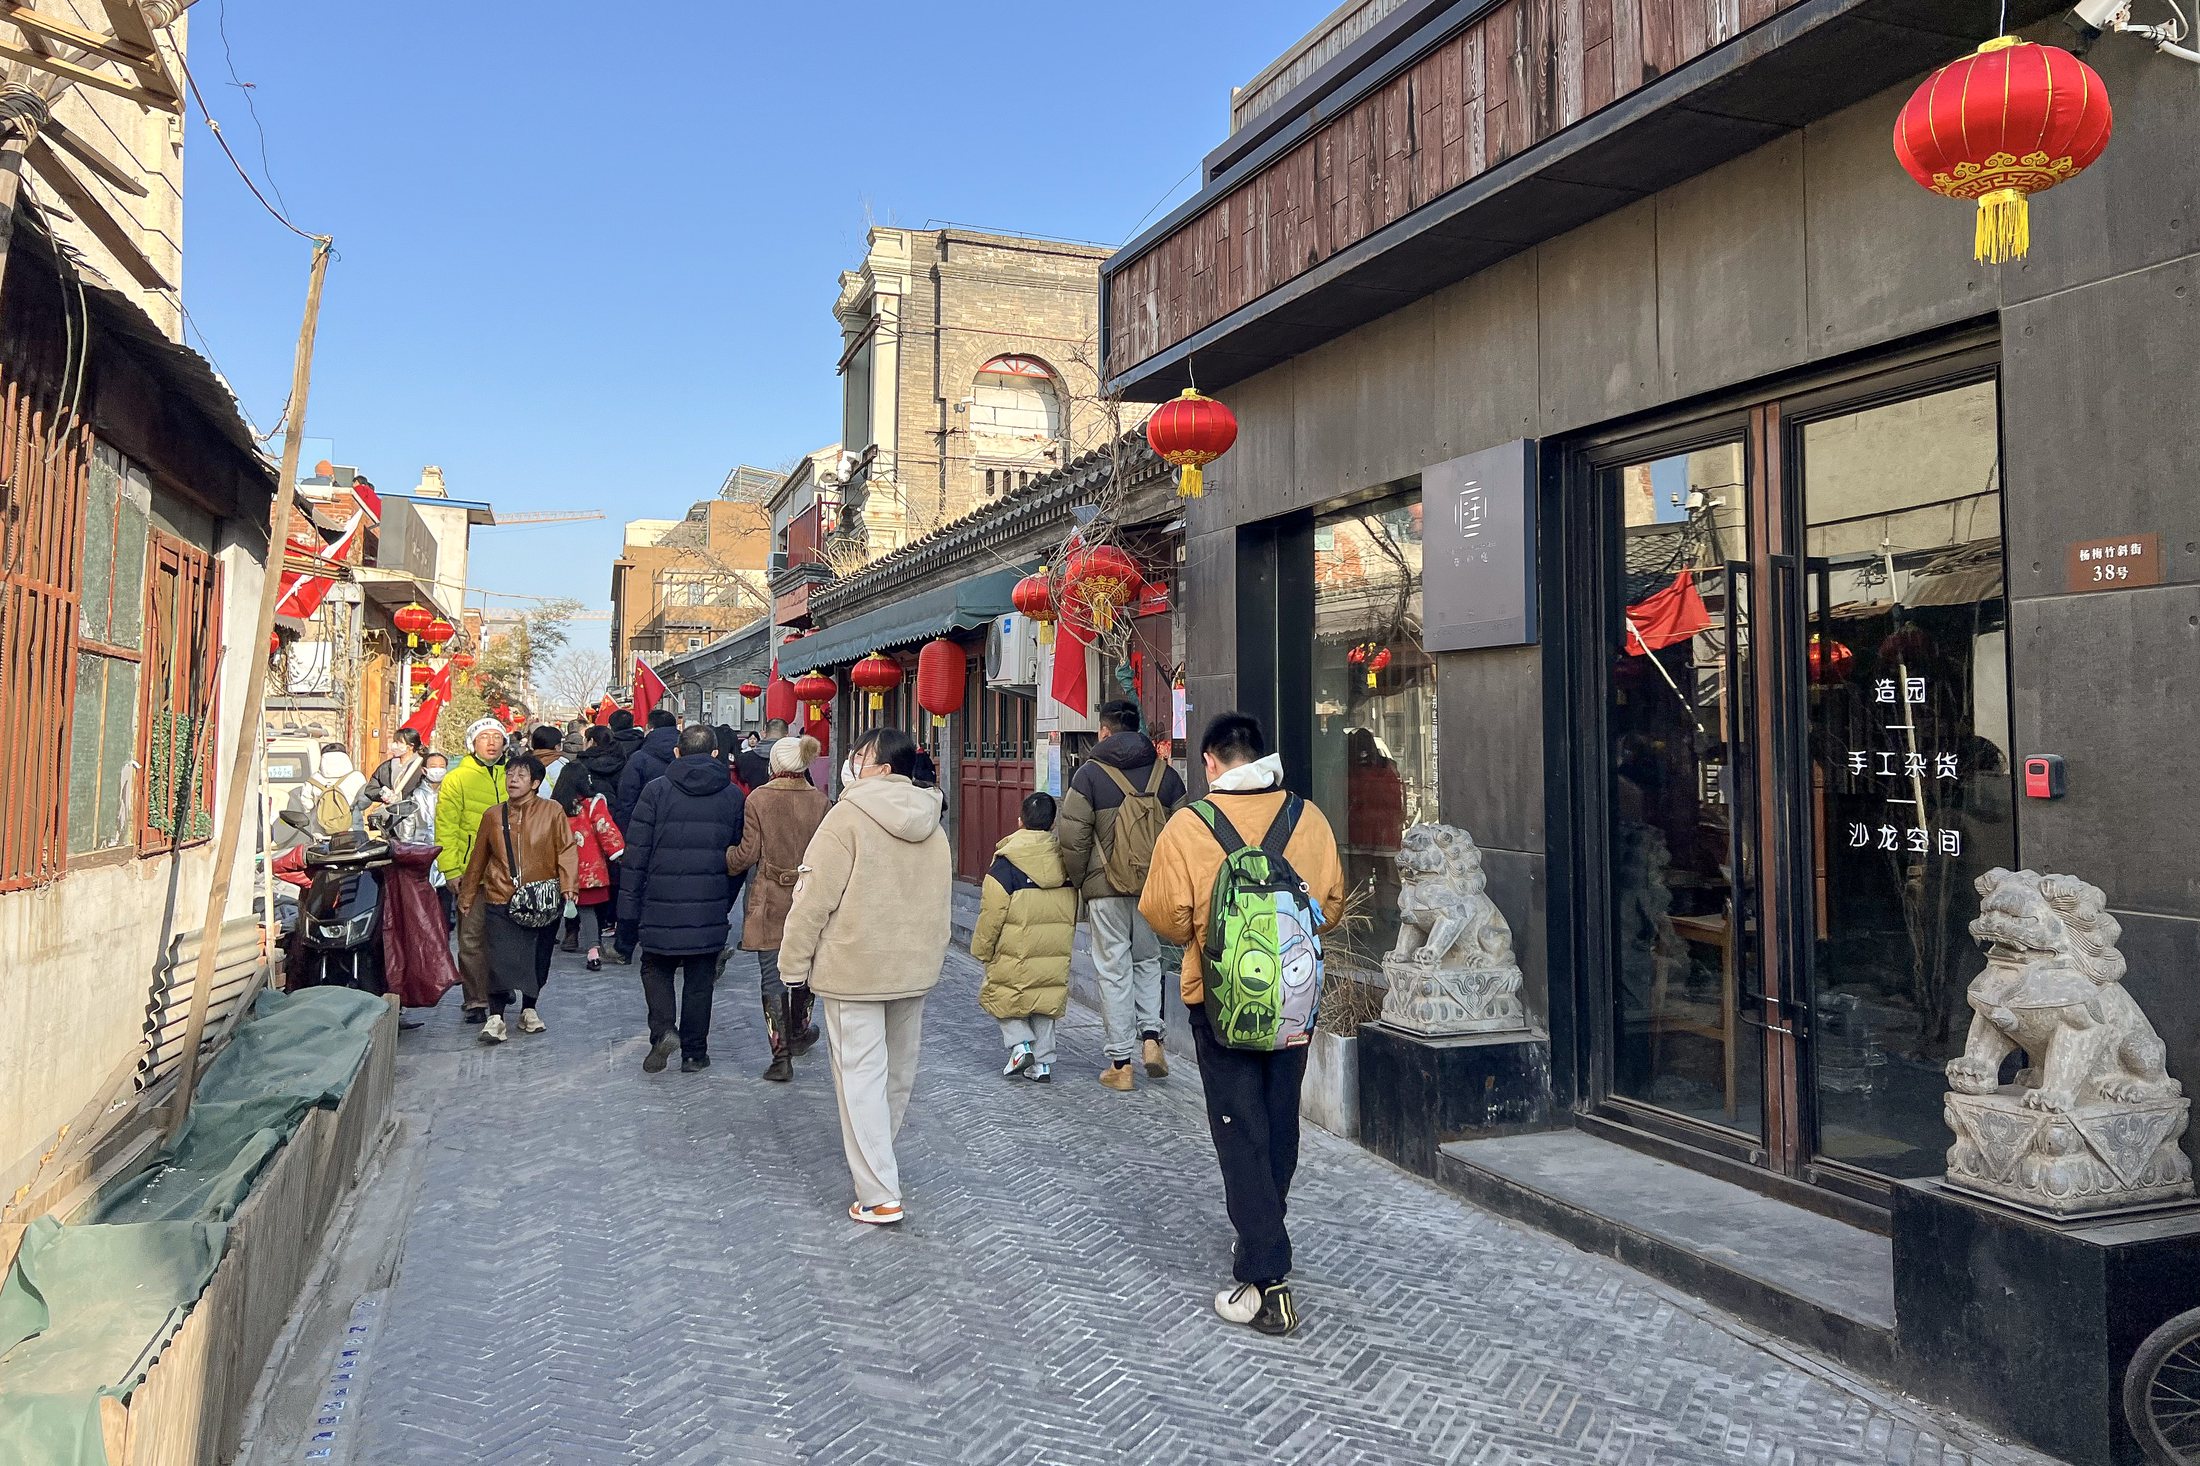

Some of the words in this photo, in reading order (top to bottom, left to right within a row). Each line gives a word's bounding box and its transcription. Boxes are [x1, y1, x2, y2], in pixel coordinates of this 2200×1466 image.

[2079, 542, 2142, 561] 杨梅竹斜街
[2092, 564, 2129, 582] 38号
[1875, 677, 1925, 703] 造园
[1848, 750, 1958, 779] 手工杂货
[1849, 821, 1960, 857] 沙龙空间
